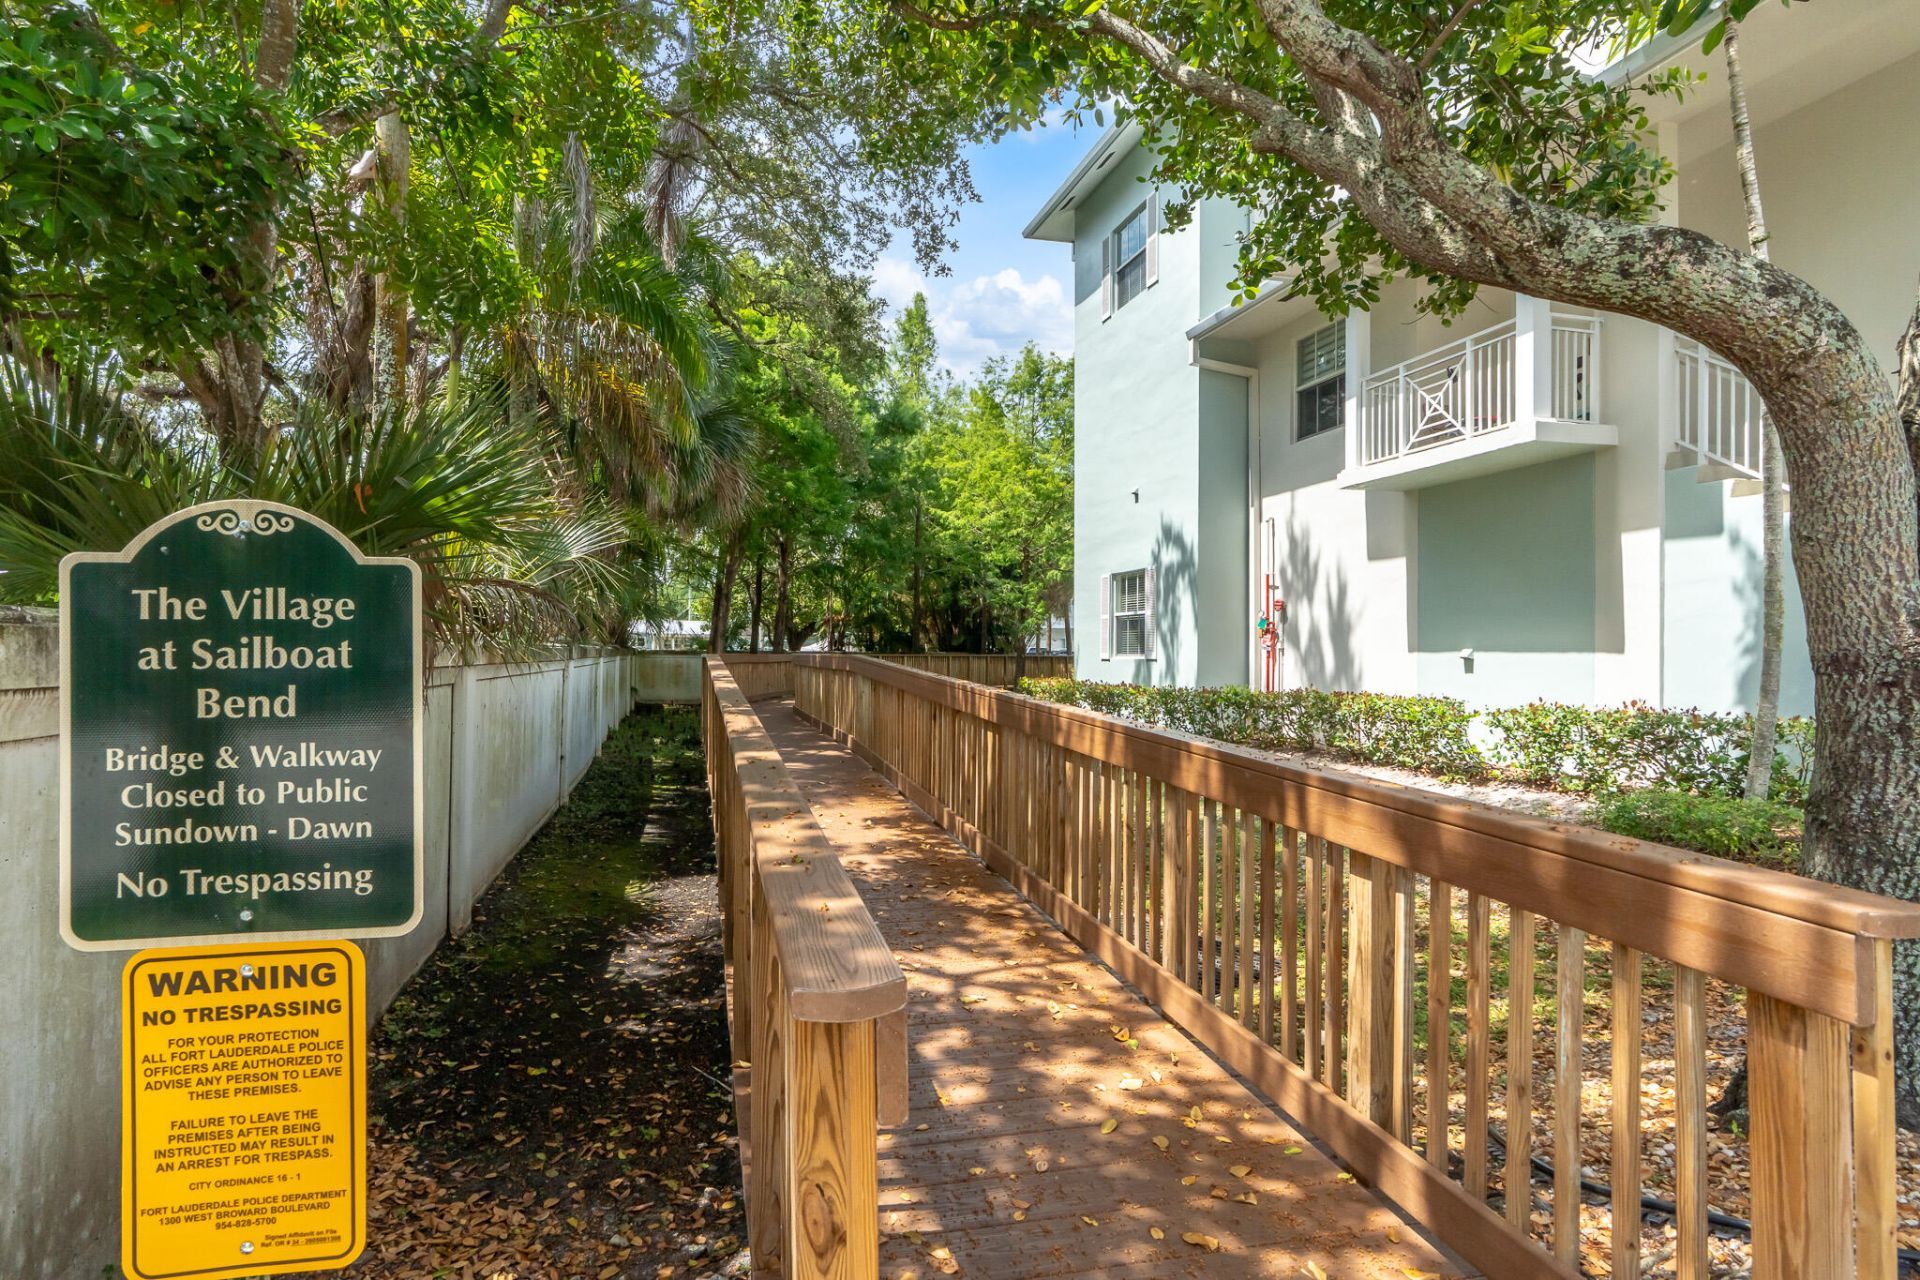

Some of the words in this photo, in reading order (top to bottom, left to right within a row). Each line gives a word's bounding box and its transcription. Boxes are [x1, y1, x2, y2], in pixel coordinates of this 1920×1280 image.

[131, 586, 208, 621] The
[221, 586, 356, 629] Village
[137, 641, 177, 670] at
[191, 635, 353, 670] Sailboat
[196, 684, 297, 719] Bend
[105, 745, 204, 777] Bridge
[215, 745, 240, 770] &
[250, 742, 383, 773] Walkway
[121, 781, 225, 809] Closed
[236, 783, 266, 806] to
[277, 778, 368, 804] Public
[114, 819, 258, 847] Sundown
[288, 816, 373, 840] Dawn
[116, 871, 168, 899] No
[180, 862, 374, 900] Trespassing
[147, 962, 337, 998] WARNING
[142, 1009, 176, 1027] NO
[183, 998, 342, 1024] TRESPASSING
[168, 1038, 195, 1049] FOR
[198, 1034, 235, 1047] YOUR
[238, 1028, 319, 1045] PROTECTION
[141, 1053, 167, 1064] ALL
[171, 1050, 205, 1061] FORT
[209, 1043, 295, 1059] LAUDERDALE
[299, 1039, 344, 1053] POLICE
[143, 1064, 209, 1078] OFFICERS
[212, 1061, 238, 1072] ARE
[242, 1055, 323, 1070] AUTHORIZED
[326, 1053, 343, 1064] TO
[144, 1078, 192, 1091] ADVISE
[195, 1075, 222, 1087] ANY
[226, 1071, 278, 1085] PERSON
[281, 1069, 299, 1080] TO
[302, 1066, 342, 1079] LEAVE
[188, 1088, 230, 1101] THESE
[233, 1083, 302, 1098] PREMISES.
[170, 1117, 225, 1131] FAILURE
[229, 1115, 246, 1125] TO
[250, 1112, 291, 1124] LEAVE
[293, 1109, 318, 1120] THE
[168, 1130, 234, 1145] PREMISES
[237, 1126, 279, 1138] AFTER
[282, 1122, 321, 1135] BEING
[154, 1143, 237, 1159] INSTRUCTED
[240, 1140, 267, 1152] MAY
[270, 1135, 318, 1148] RESULT
[322, 1134, 334, 1144] IN
[155, 1162, 174, 1173] AN
[177, 1157, 230, 1171] ARREST
[234, 1154, 260, 1166] FOR
[265, 1148, 333, 1163] TRESPASS.
[189, 1181, 211, 1191] CITY
[214, 1175, 275, 1189] ORDINANCE
[277, 1174, 287, 1182] 16
[297, 1173, 301, 1181] 1
[141, 1206, 169, 1217] FORT
[171, 1199, 240, 1214] LAUDERDALE
[242, 1195, 279, 1207] POLICE
[281, 1189, 347, 1203] DEPARTMENT
[158, 1217, 181, 1226] 1300
[184, 1213, 213, 1223] WEST
[216, 1207, 268, 1220] BROWARD
[271, 1201, 330, 1215] BOULEVARD
[215, 1216, 277, 1230] 954-828-5700
